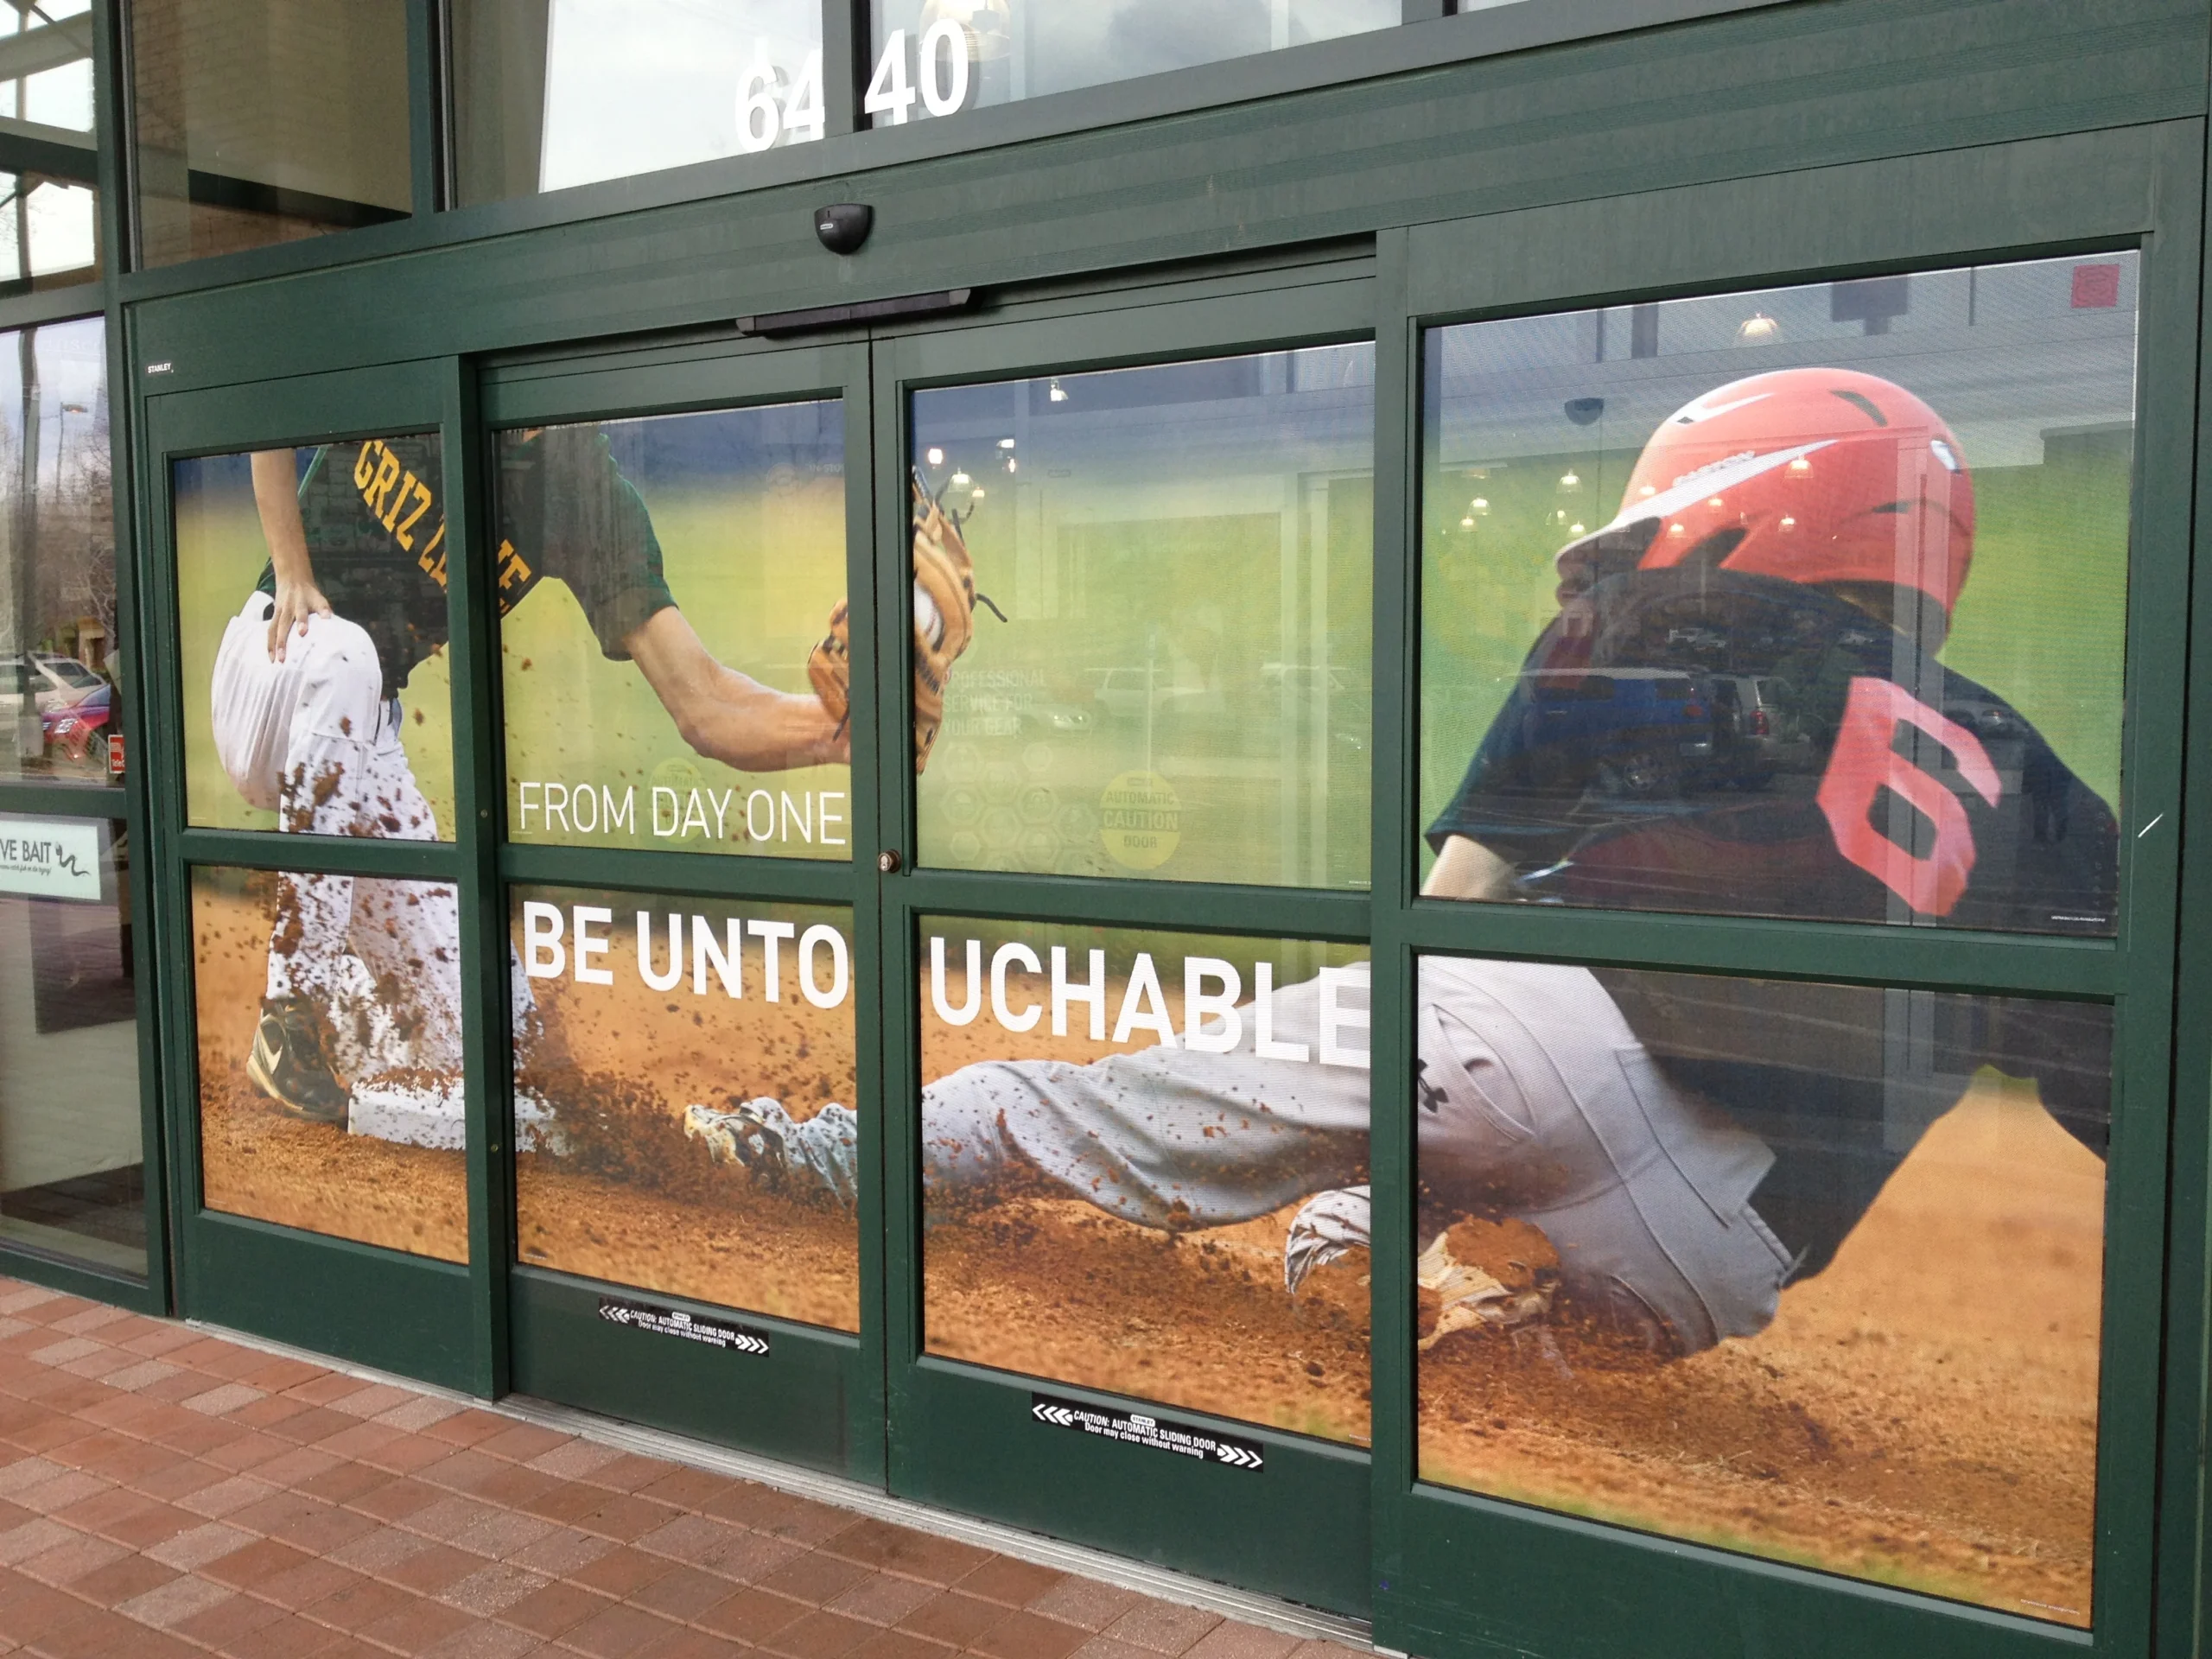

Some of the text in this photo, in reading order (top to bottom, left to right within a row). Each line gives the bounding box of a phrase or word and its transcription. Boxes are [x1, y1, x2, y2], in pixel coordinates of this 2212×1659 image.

[148, 363, 171, 373] STANLEY
[1105, 790, 1175, 806] AUTOMATIC
[1815, 676, 2002, 917] 6
[519, 781, 846, 845] FROM DAY ONE
[1103, 810, 1179, 830] CAUTION
[22, 840, 52, 864] BAIT
[1123, 834, 1158, 849] DOOR
[523, 900, 613, 986] BE
[630, 1310, 657, 1324] CAUTION:
[658, 1316, 693, 1331] AUTOMATIC
[693, 1323, 717, 1338] SLIDING
[718, 1329, 735, 1341] DOOR
[639, 1319, 727, 1348] Door may close without warning
[1074, 1410, 1216, 1452] CAUTION: AUTOMATIC SLIDING DOOR
[1084, 1421, 1204, 1459] Door may close without warning
